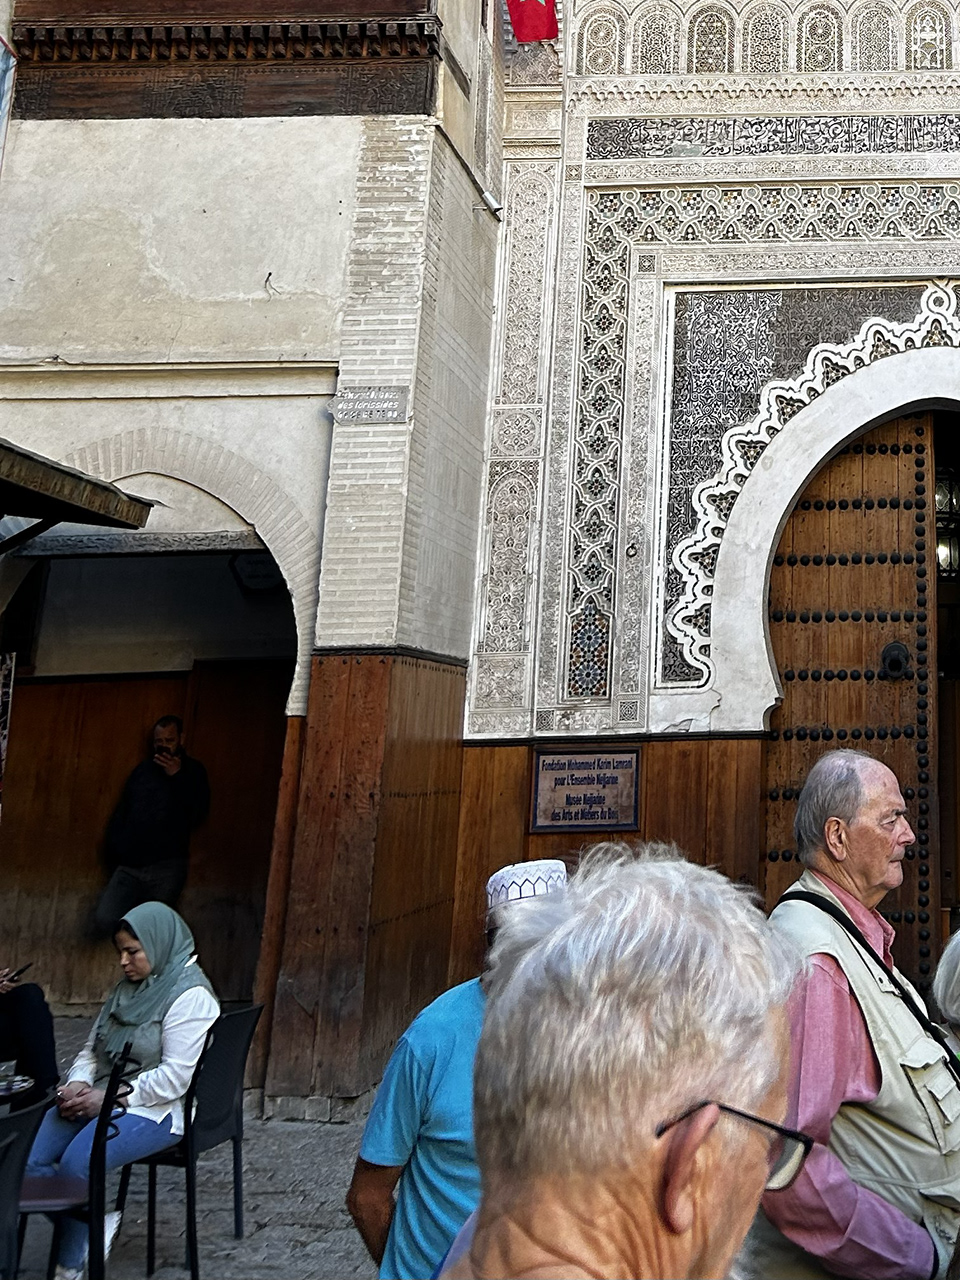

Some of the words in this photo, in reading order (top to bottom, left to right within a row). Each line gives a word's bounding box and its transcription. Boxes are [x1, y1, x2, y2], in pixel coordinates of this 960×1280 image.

[542, 759, 566, 771] Fondation
[567, 758, 596, 770] Mohammed
[597, 758, 611, 770] Karim
[613, 757, 632, 769] Lamrani
[554, 777, 566, 789] pour
[551, 809, 562, 821] des
[562, 809, 573, 821] Arts
[574, 809, 580, 820] et
[601, 808, 607, 820] du
